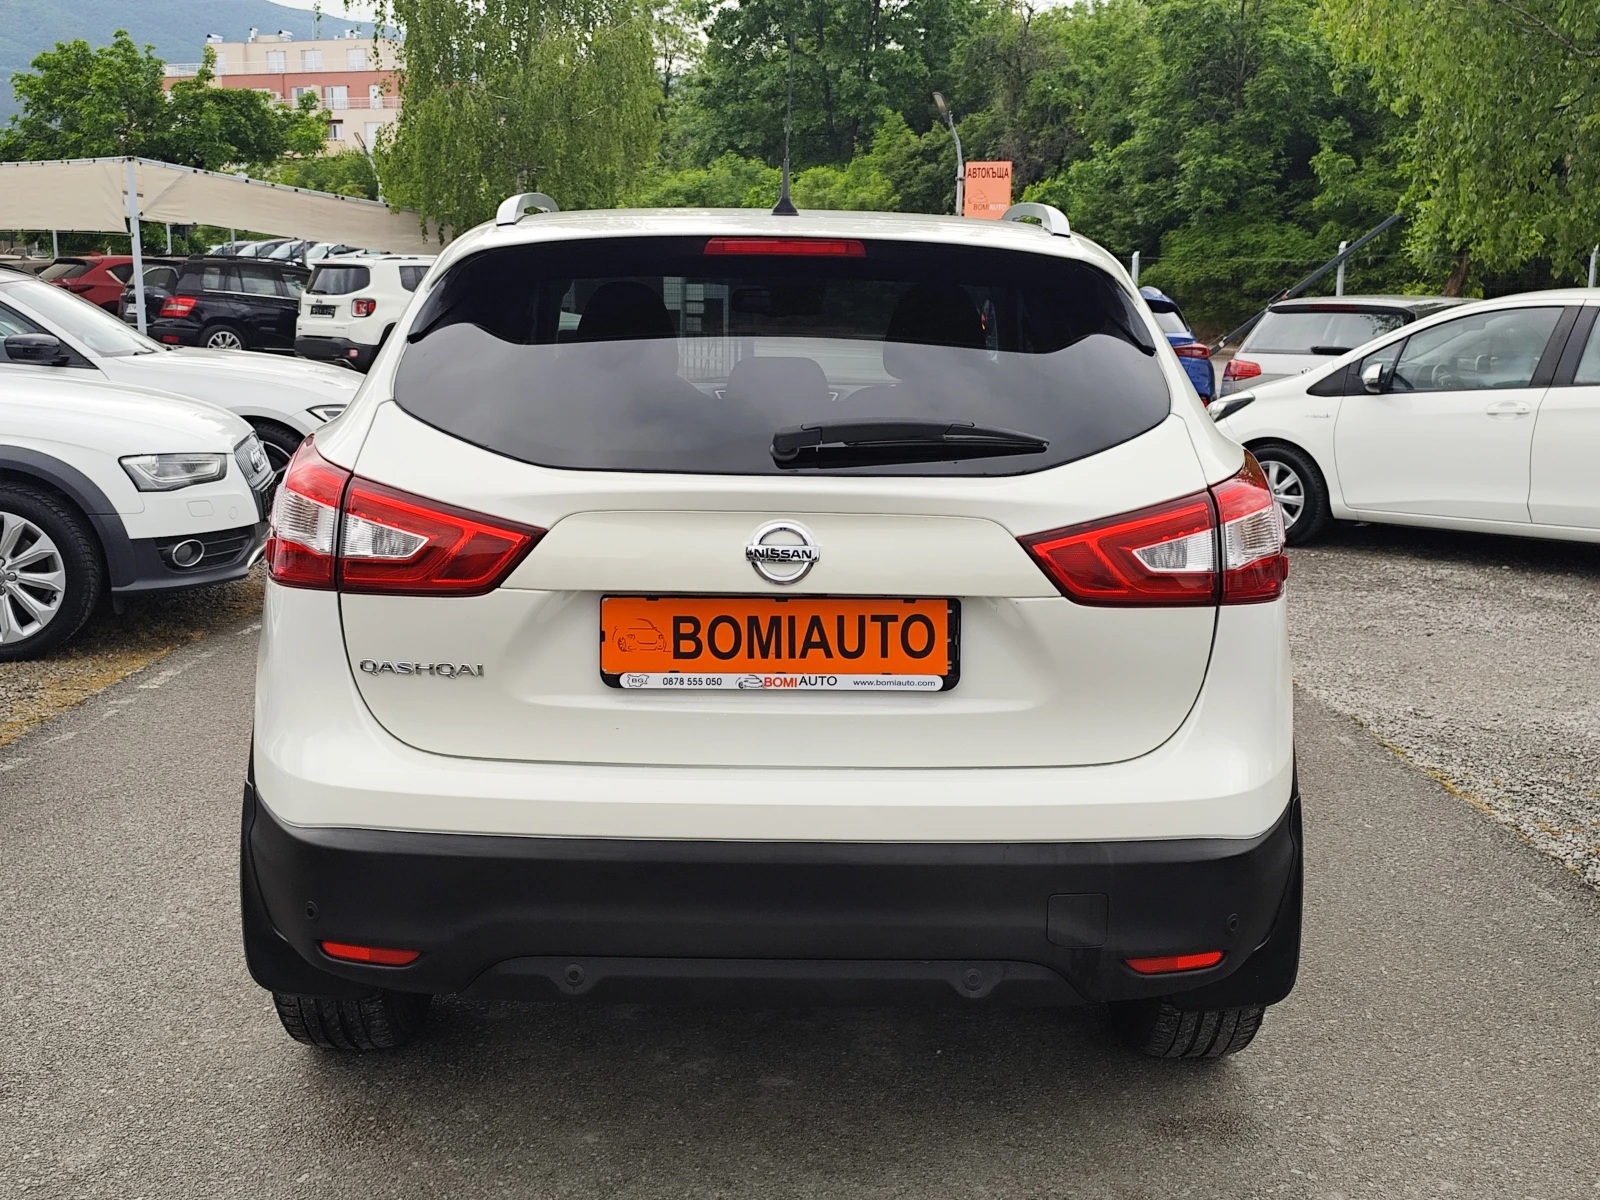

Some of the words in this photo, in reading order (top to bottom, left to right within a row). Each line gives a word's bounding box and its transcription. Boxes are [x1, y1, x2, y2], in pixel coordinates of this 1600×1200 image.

[967, 167, 1009, 180] АВТОКЪЩА
[753, 548, 812, 560] NISSAN
[672, 614, 936, 660] BOMIAUTO
[360, 658, 484, 679] QASHQAI
[662, 677, 685, 686] 0878
[687, 677, 704, 686] 555
[705, 677, 723, 686] 050
[853, 679, 936, 687] www.bomiauto.com
